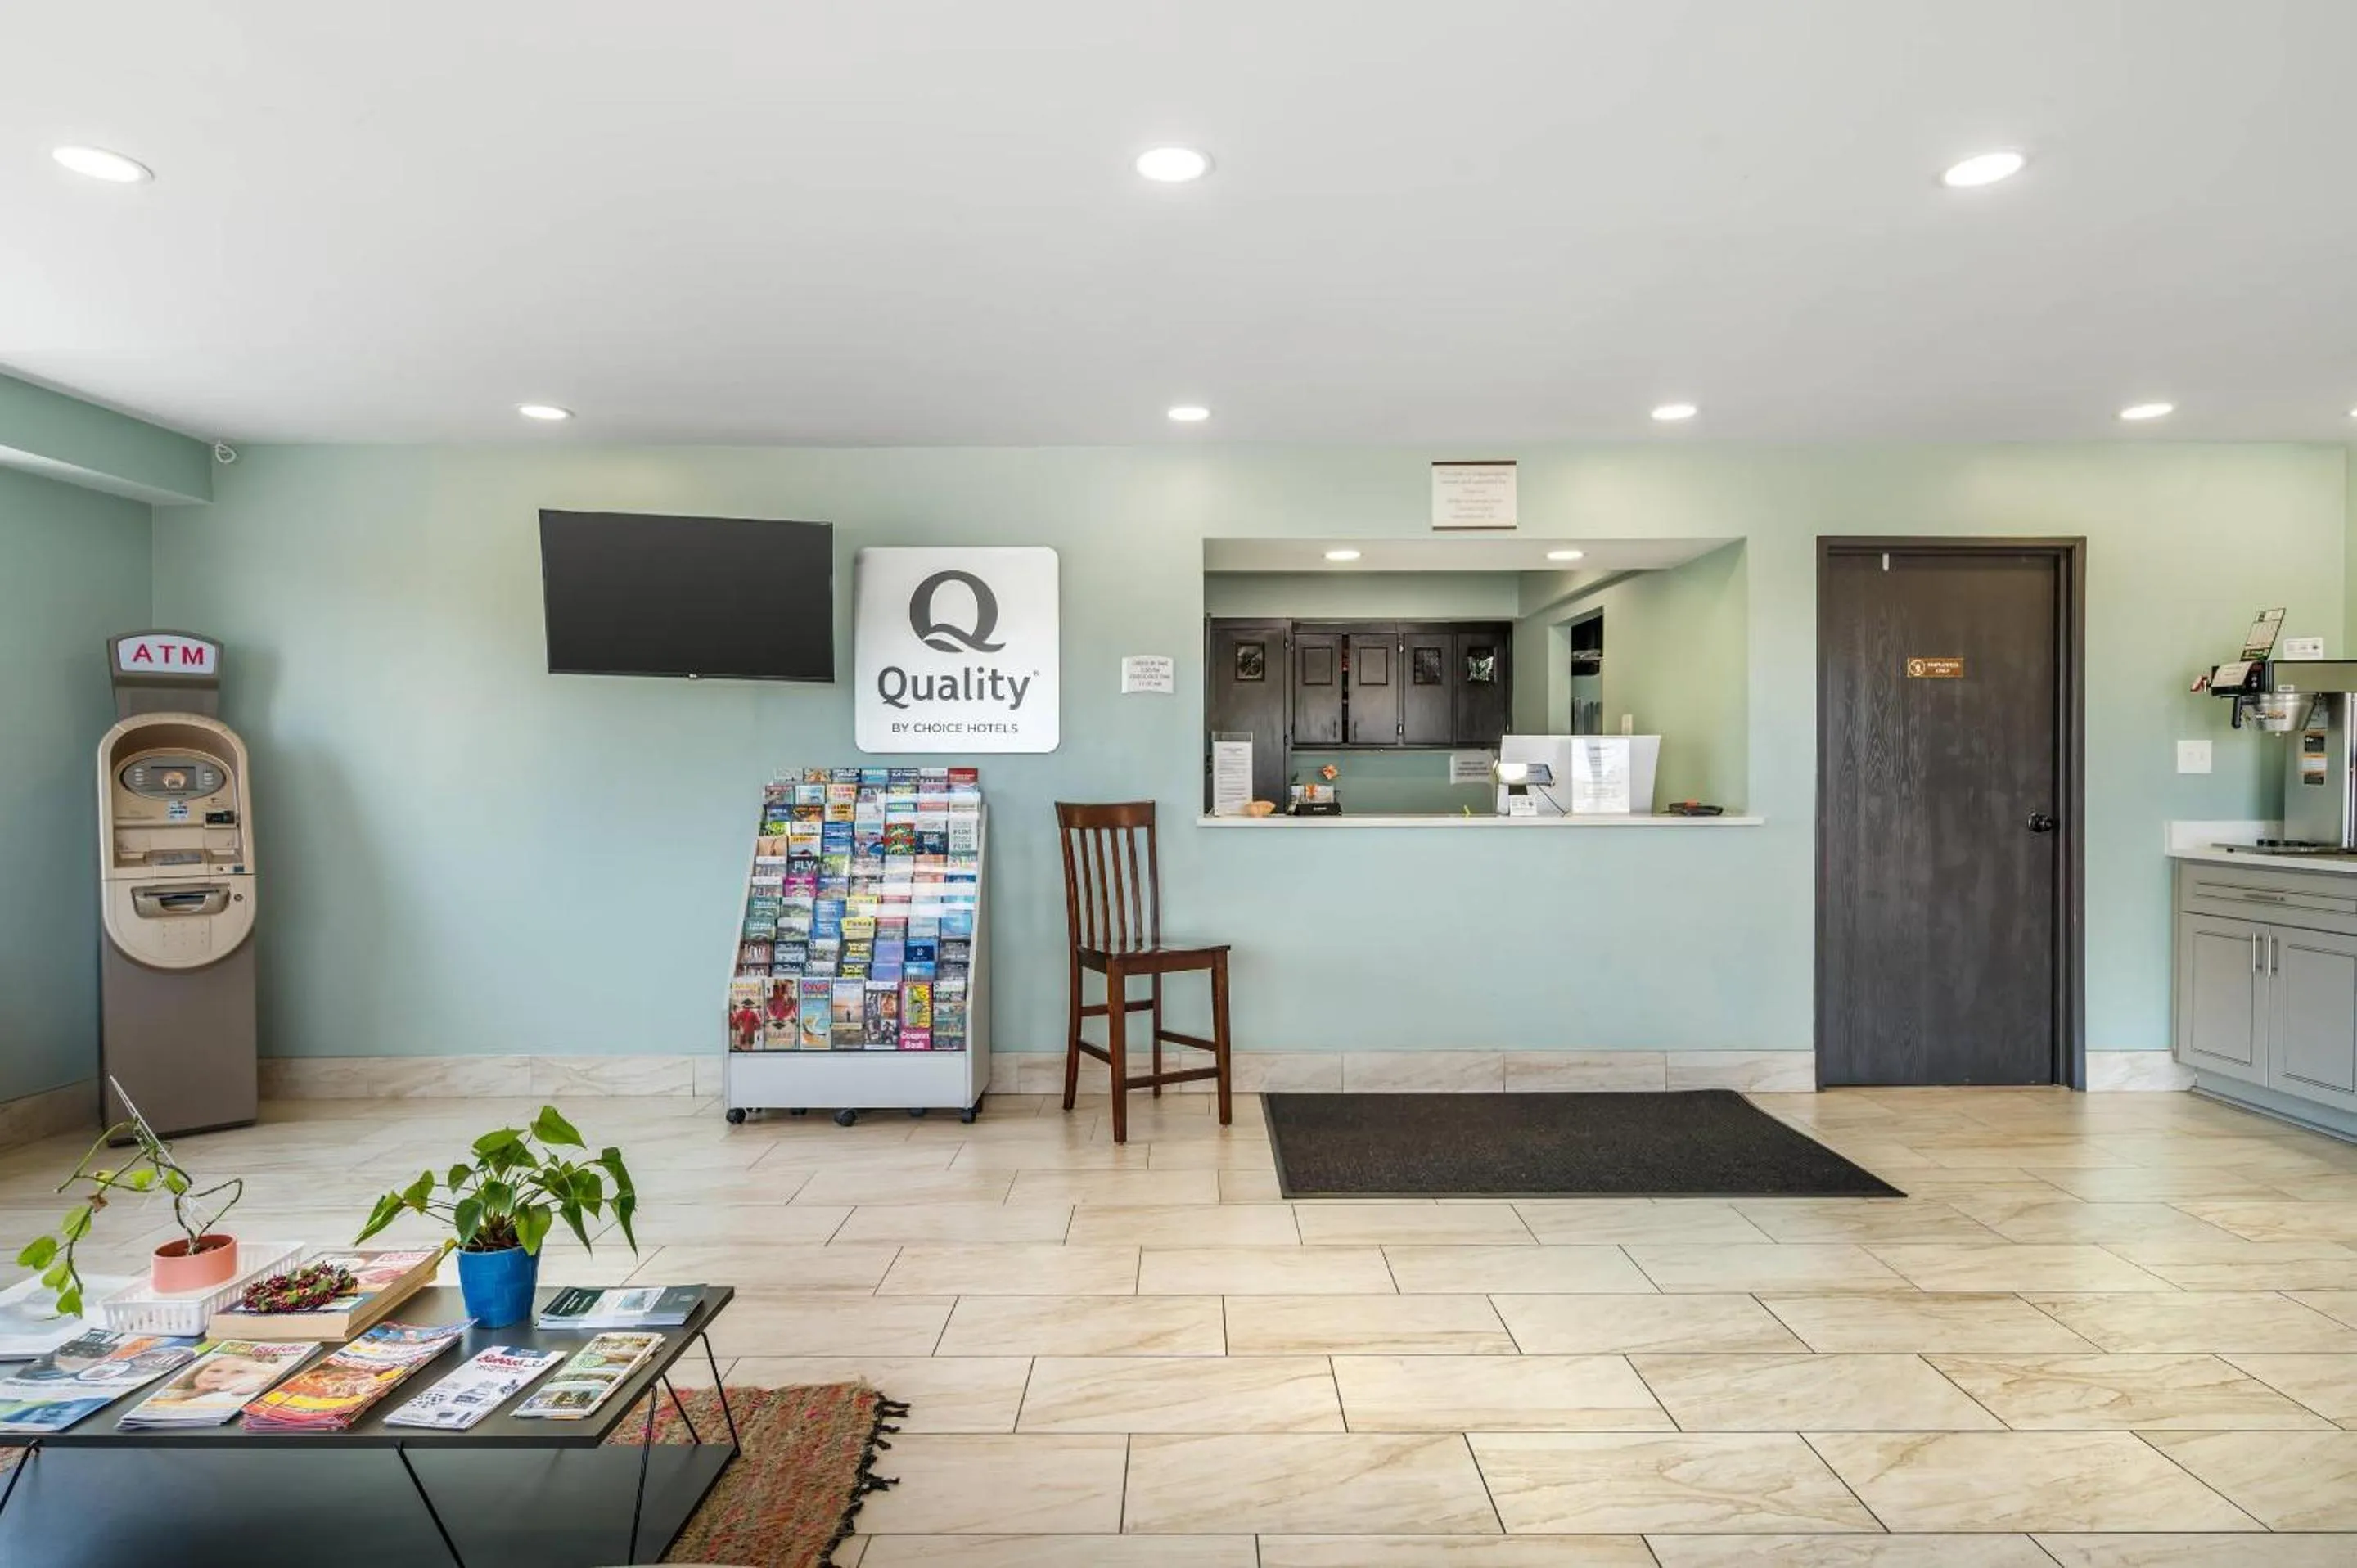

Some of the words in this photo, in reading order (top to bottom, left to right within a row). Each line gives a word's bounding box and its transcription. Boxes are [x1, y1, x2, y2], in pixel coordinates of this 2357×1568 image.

[909, 570, 1006, 653] Q
[133, 642, 205, 665] ATM
[877, 666, 1032, 710] Quality
[891, 723, 908, 733] BY
[913, 723, 962, 733] CHOICE
[967, 723, 1018, 733] HOTELS
